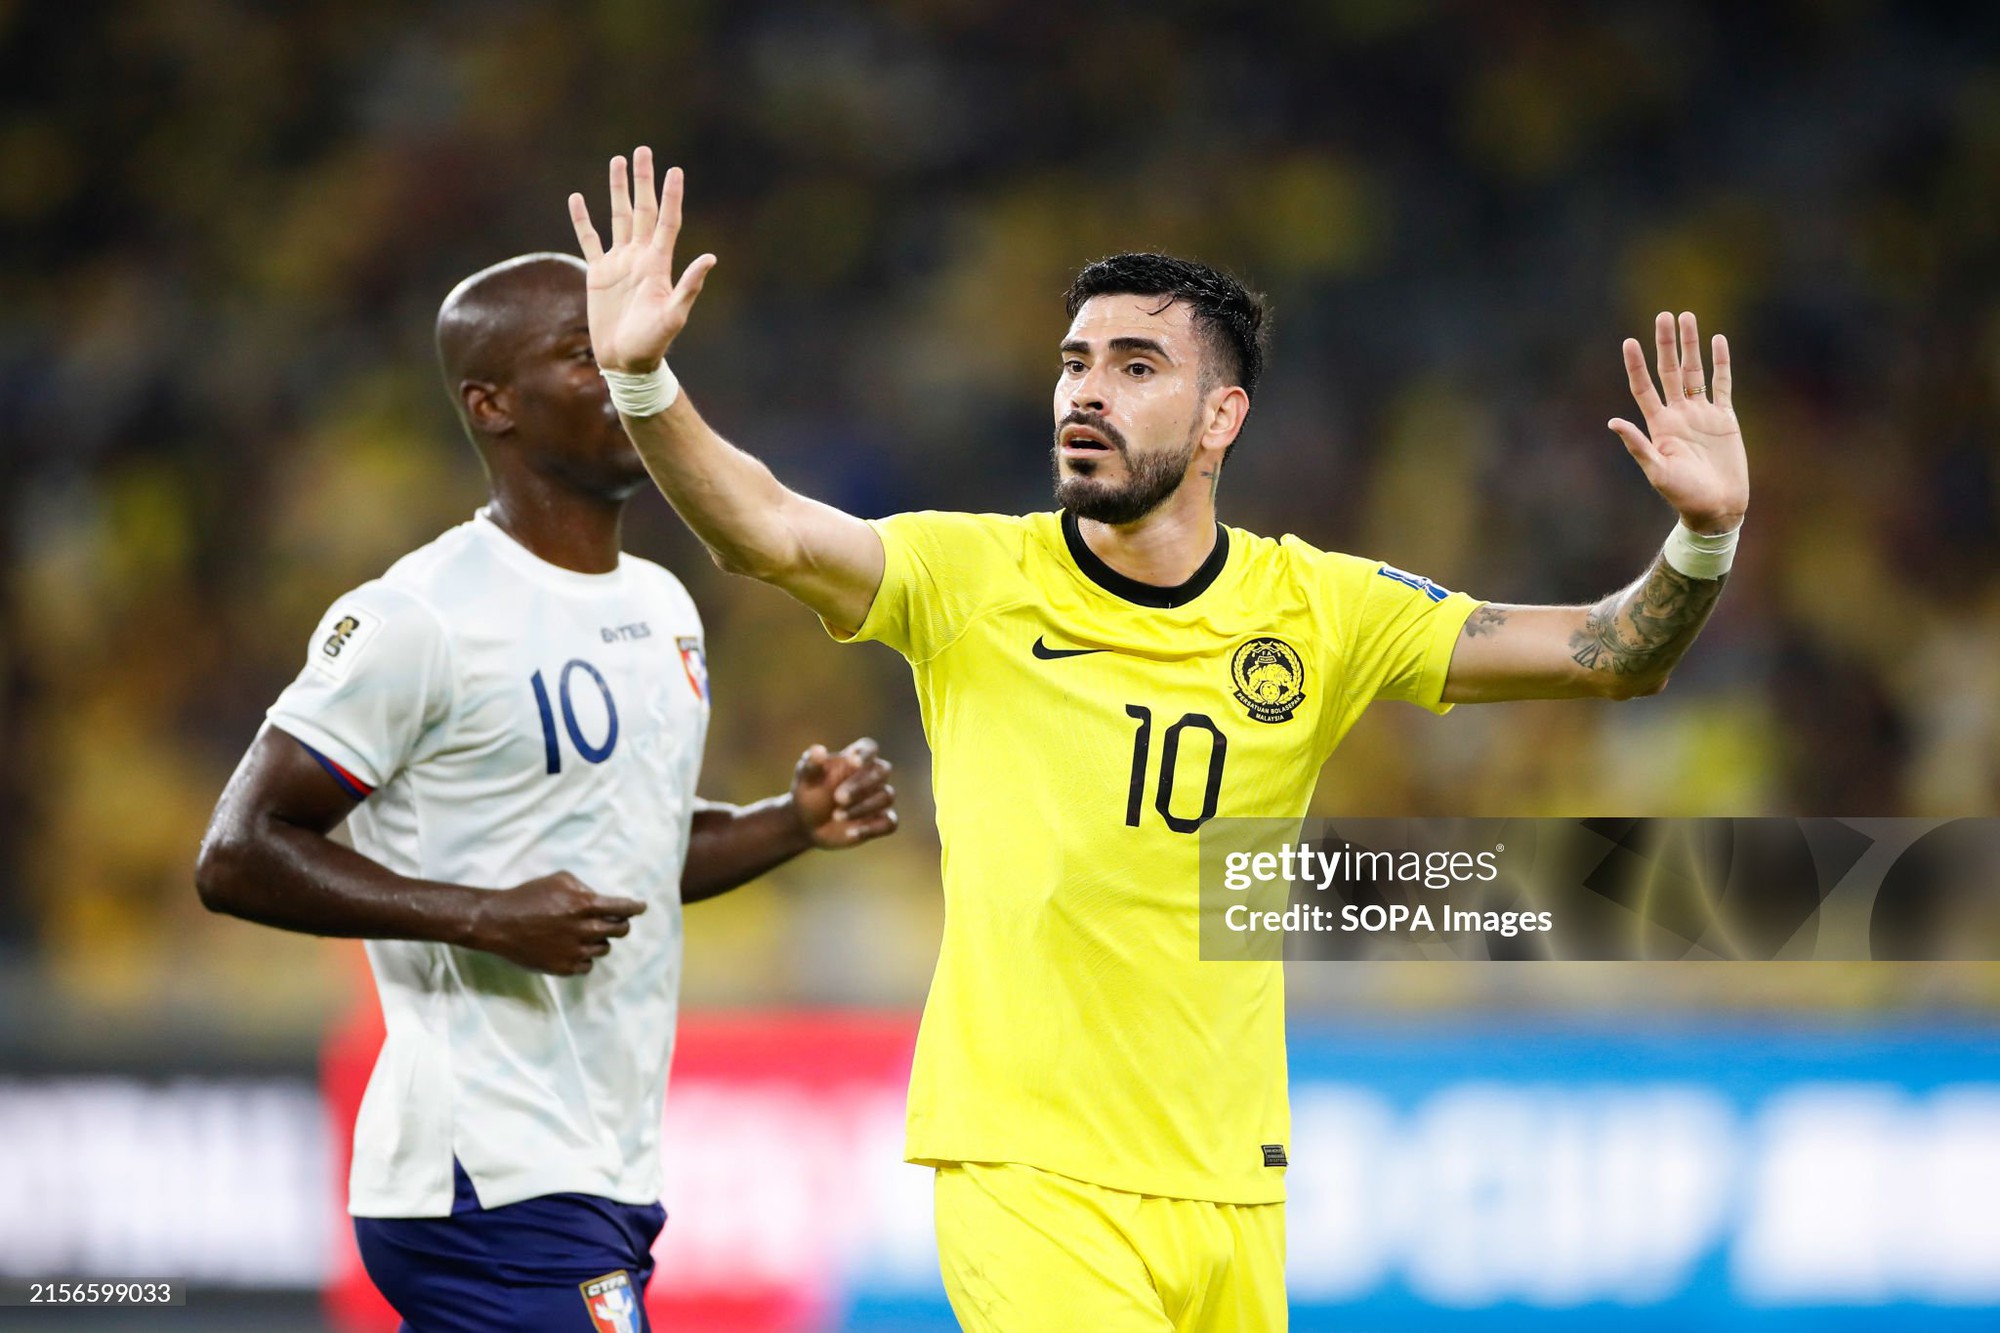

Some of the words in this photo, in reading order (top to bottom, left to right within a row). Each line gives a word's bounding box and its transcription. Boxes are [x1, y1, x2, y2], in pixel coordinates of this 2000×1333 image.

[531, 658, 618, 775] 10
[1236, 692, 1270, 714] PERSATUAN
[1270, 696, 1301, 715] BOLASEPAK
[1255, 713, 1285, 722] MALAYSIA
[1126, 704, 1227, 834] 10
